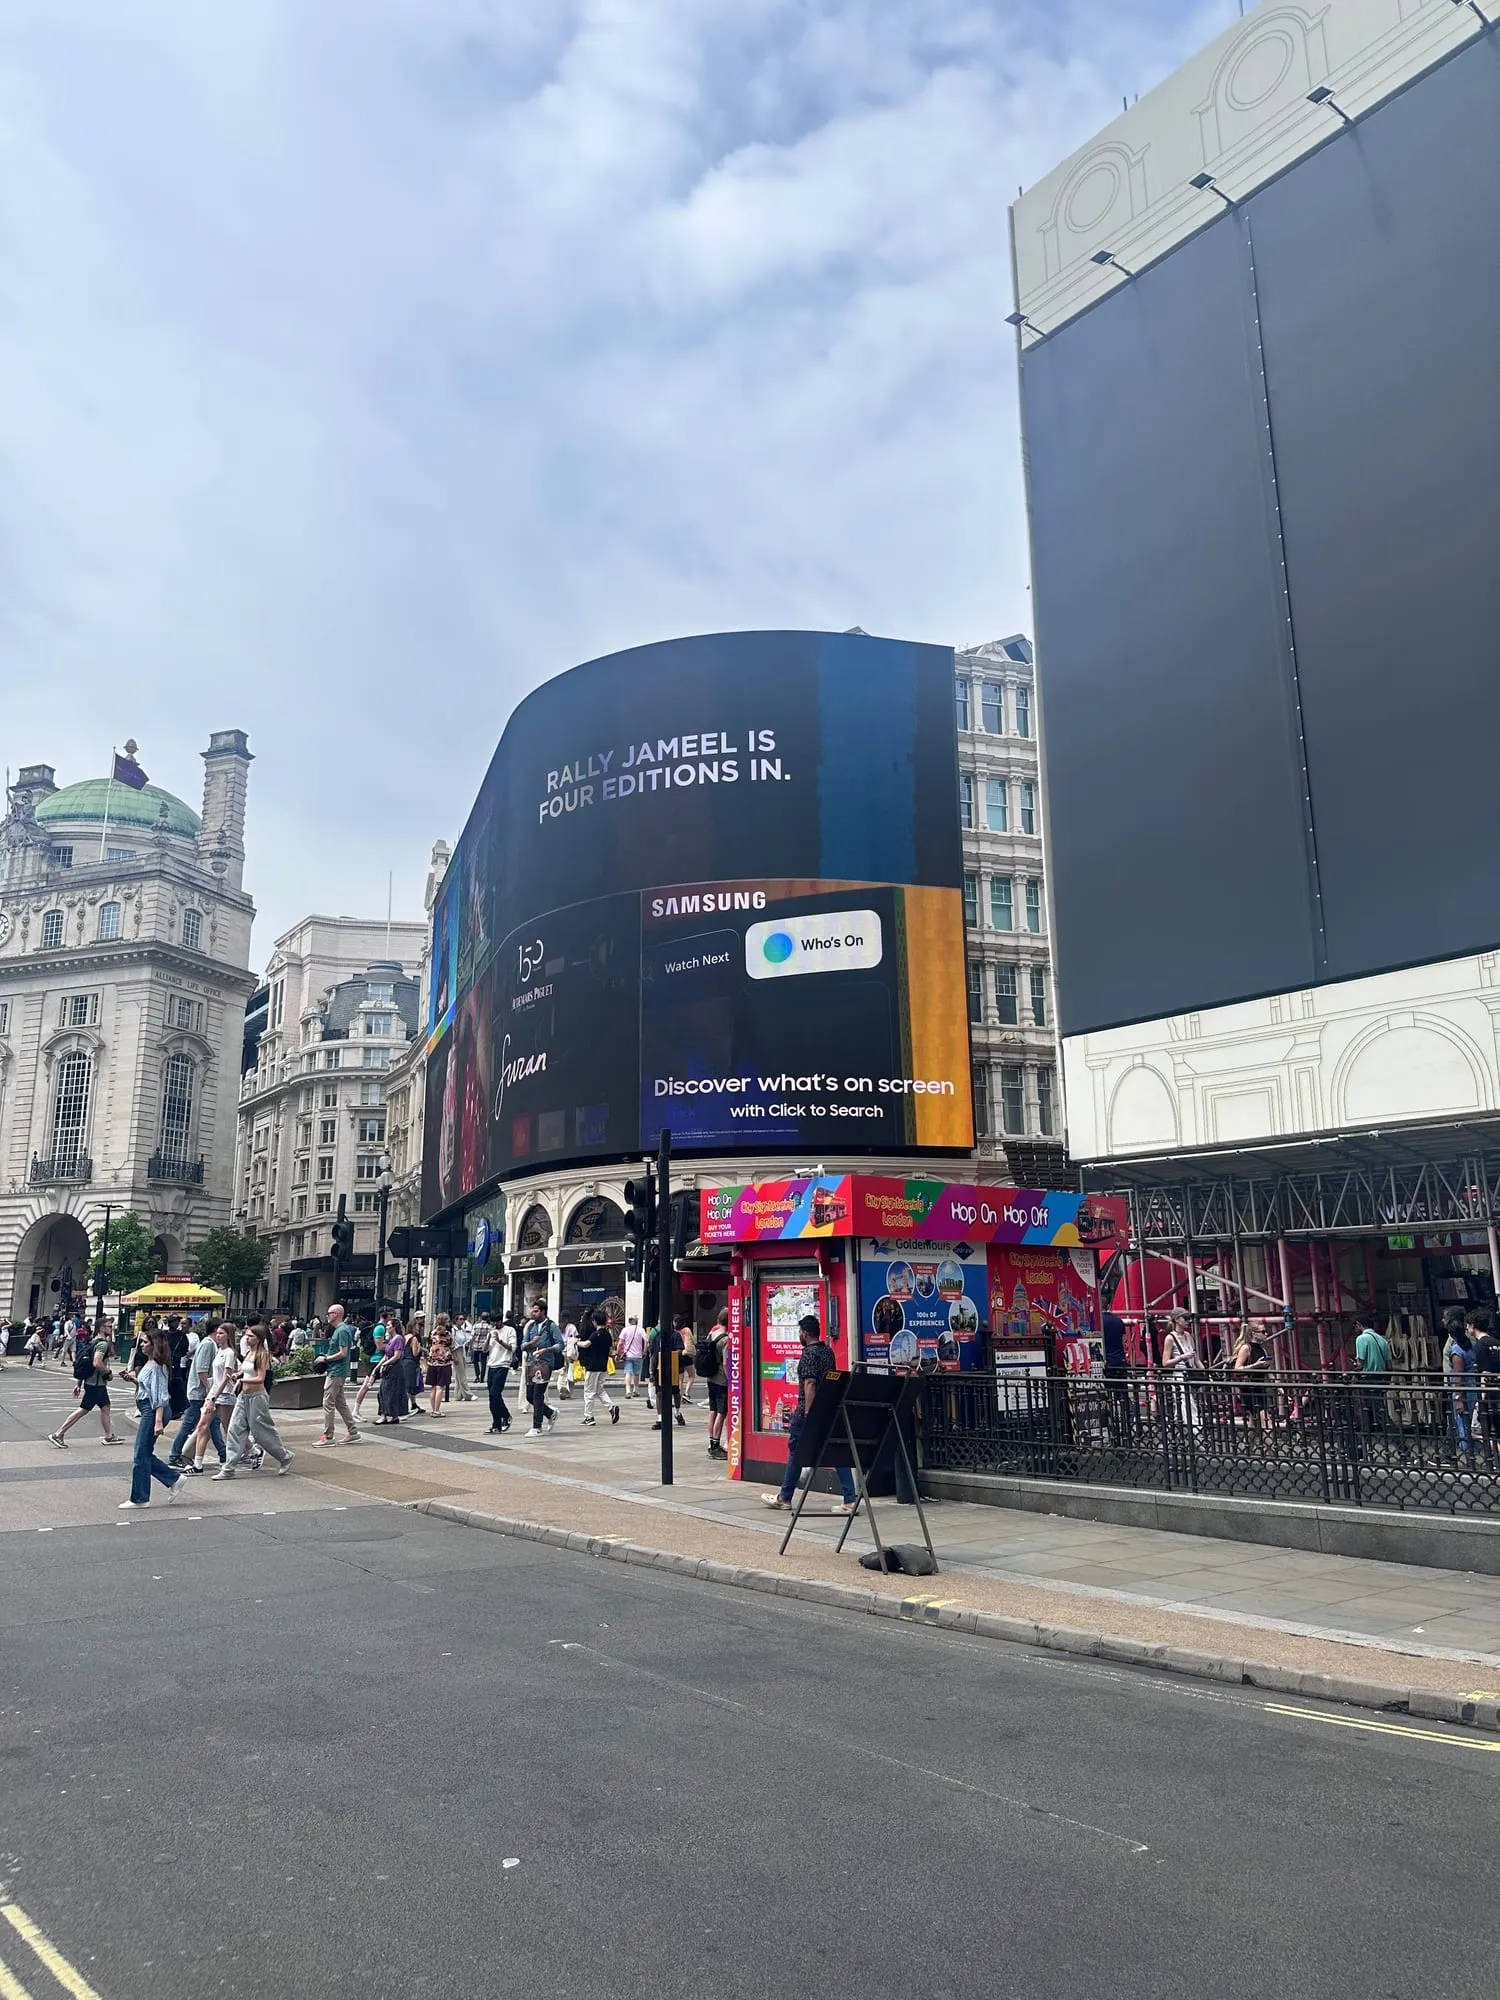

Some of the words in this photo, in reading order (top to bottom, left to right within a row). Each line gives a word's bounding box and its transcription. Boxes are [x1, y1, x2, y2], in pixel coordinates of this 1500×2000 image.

[546, 750, 614, 794] RALLY
[622, 731, 738, 768] JAMEEL
[748, 729, 776, 752] IS
[538, 784, 595, 825] FOUR
[602, 760, 739, 801] EDITIONS
[750, 758, 791, 781] IN.
[651, 890, 767, 917] SAMSUNG
[801, 936, 841, 952] Who's
[844, 934, 864, 948] On
[664, 957, 699, 974] Watch
[702, 951, 730, 967] Next
[155, 971, 182, 986] ALLIANCE
[187, 980, 199, 992] LIFE
[203, 986, 222, 998] OFFICE
[533, 983, 554, 1000] PIGUET
[653, 1075, 752, 1097] Discover
[757, 1073, 839, 1092] what's
[844, 1076, 873, 1093] on
[877, 1078, 955, 1096] screen
[729, 1104, 766, 1118] with
[768, 1103, 807, 1118] Click
[810, 1104, 827, 1118] to
[829, 1103, 884, 1119] Search
[707, 1194, 721, 1206] Hop
[722, 1192, 732, 1204] On
[740, 1201, 754, 1215] City
[754, 1199, 796, 1214] Sightseeing
[864, 1193, 882, 1209] City
[880, 1195, 924, 1213] Sightseeing
[707, 1208, 721, 1221] Hop
[721, 1207, 732, 1220] Off
[755, 1214, 785, 1230] London
[882, 1211, 913, 1228] London
[950, 1200, 978, 1225] Hop
[980, 1202, 998, 1224] On
[1002, 1204, 1028, 1227] Hop
[1030, 1205, 1049, 1228] Off
[576, 1250, 600, 1262] Lindt
[1025, 1269, 1055, 1285] London
[731, 1298, 740, 1334] HERE
[908, 1319, 945, 1327] EXPERIENCES
[731, 1338, 740, 1391] TICKETS
[731, 1395, 740, 1435] YOUR
[731, 1438, 740, 1466] BUY
